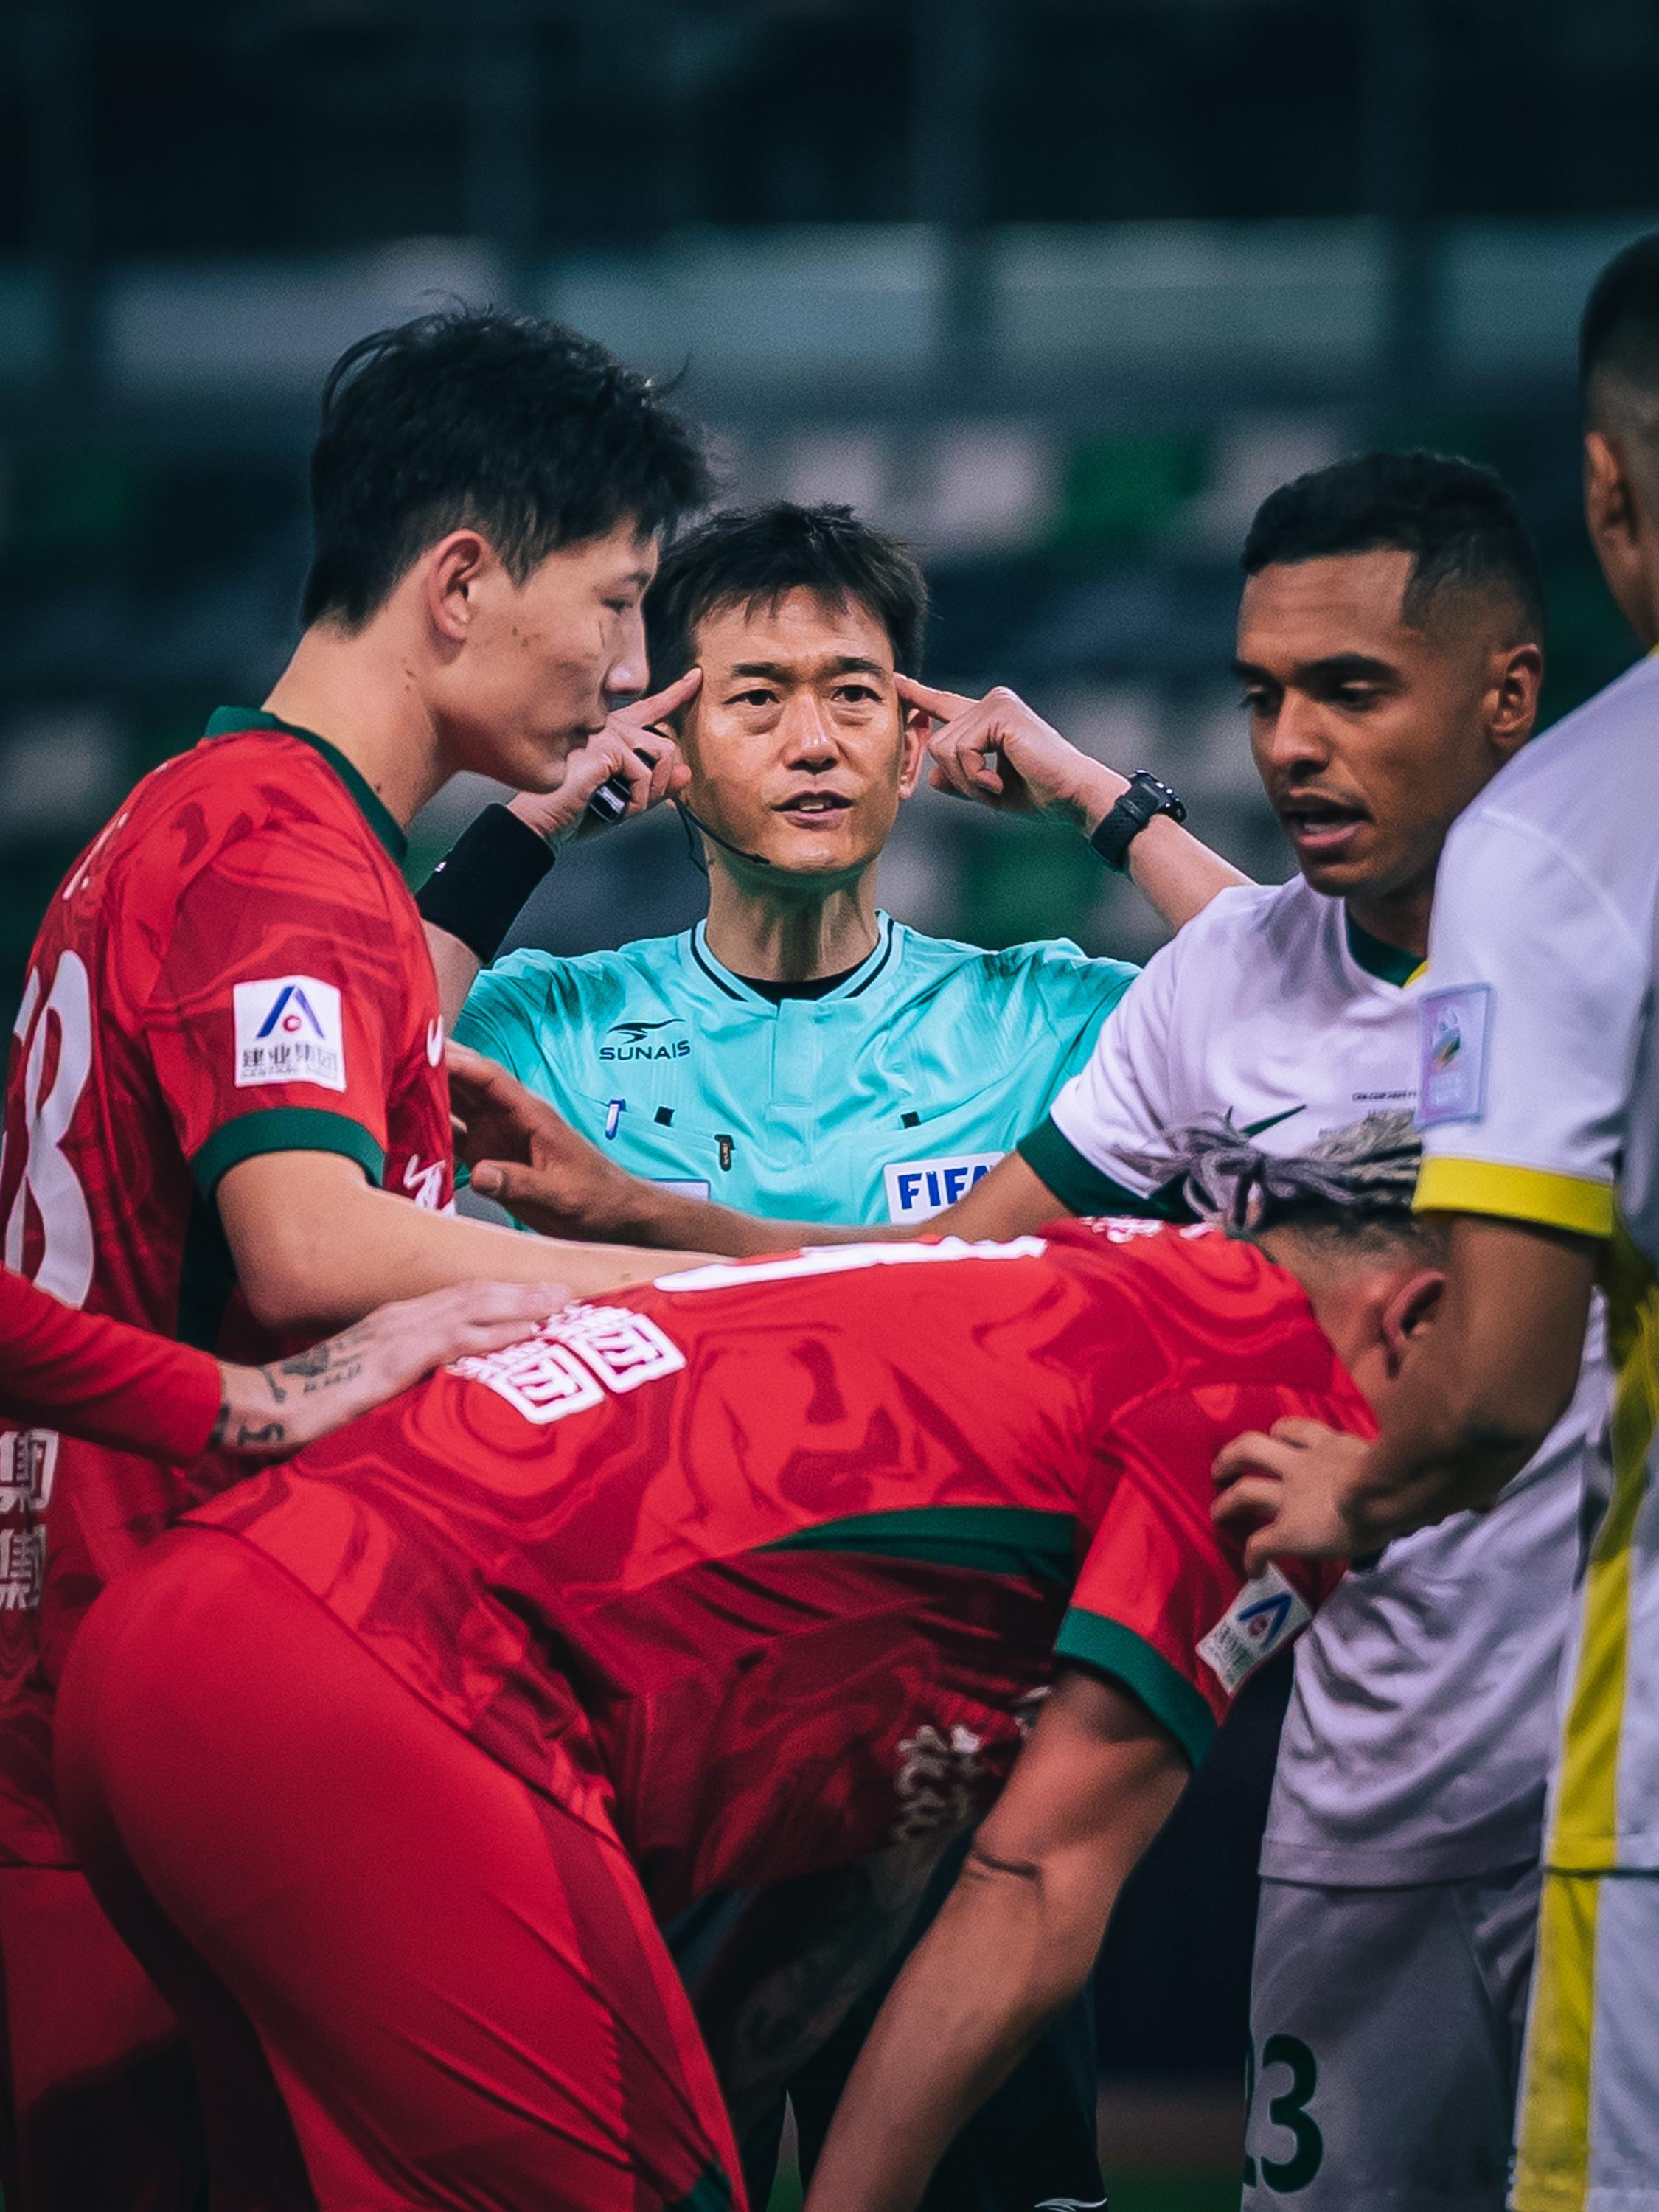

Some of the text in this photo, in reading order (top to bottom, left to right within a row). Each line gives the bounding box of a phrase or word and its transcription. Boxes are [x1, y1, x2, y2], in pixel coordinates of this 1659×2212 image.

[0, 950, 94, 1310] 8
[599, 1039, 691, 1061] SUNAIS
[1243, 2033, 1323, 2195] 3
